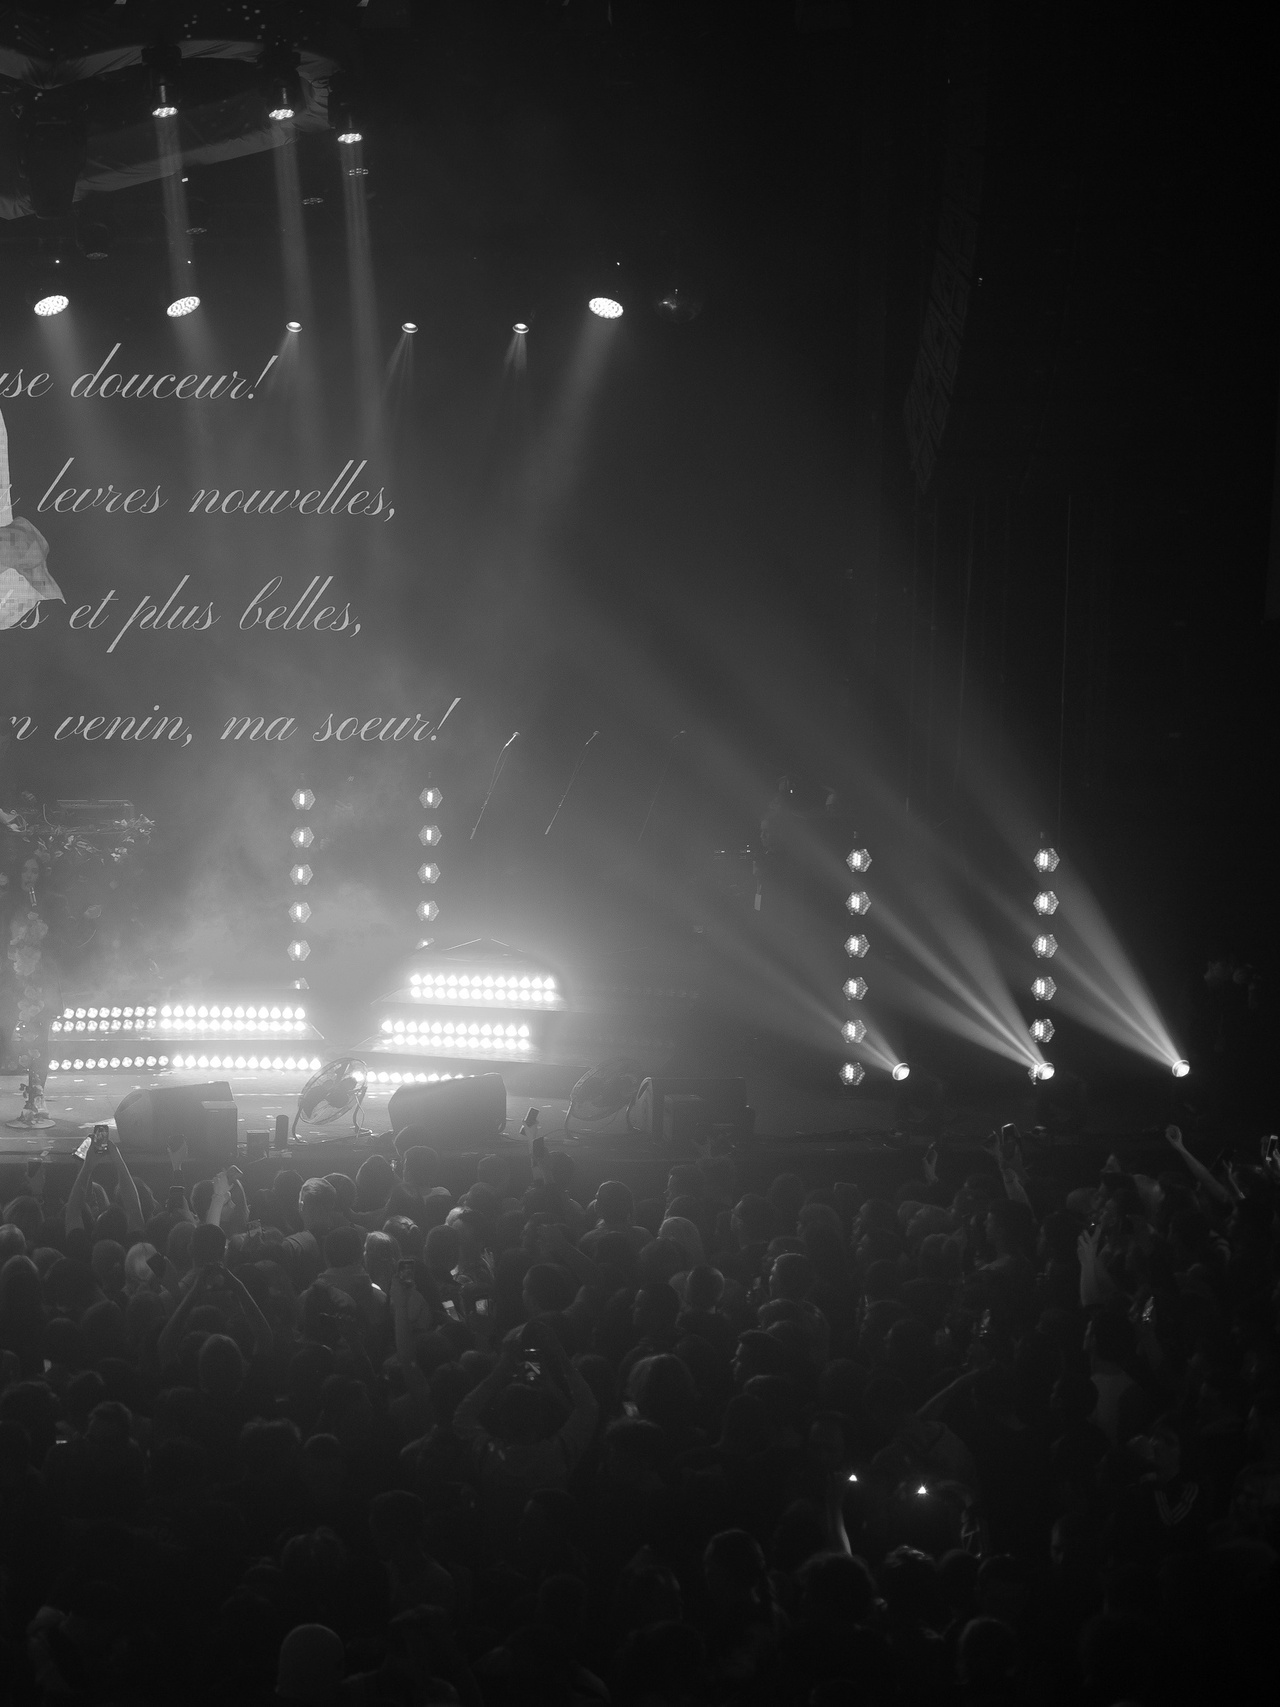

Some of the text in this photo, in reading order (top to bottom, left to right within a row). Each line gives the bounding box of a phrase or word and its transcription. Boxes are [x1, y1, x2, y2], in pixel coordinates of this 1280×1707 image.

[70, 343, 278, 400] douceur!
[37, 457, 169, 513] levres
[189, 459, 395, 522] nouvelles,
[69, 589, 119, 630] et
[106, 575, 221, 653] plus
[238, 575, 362, 638] belles,
[54, 705, 194, 748] venin,
[220, 716, 297, 741] ma
[312, 697, 462, 742] soeur!
